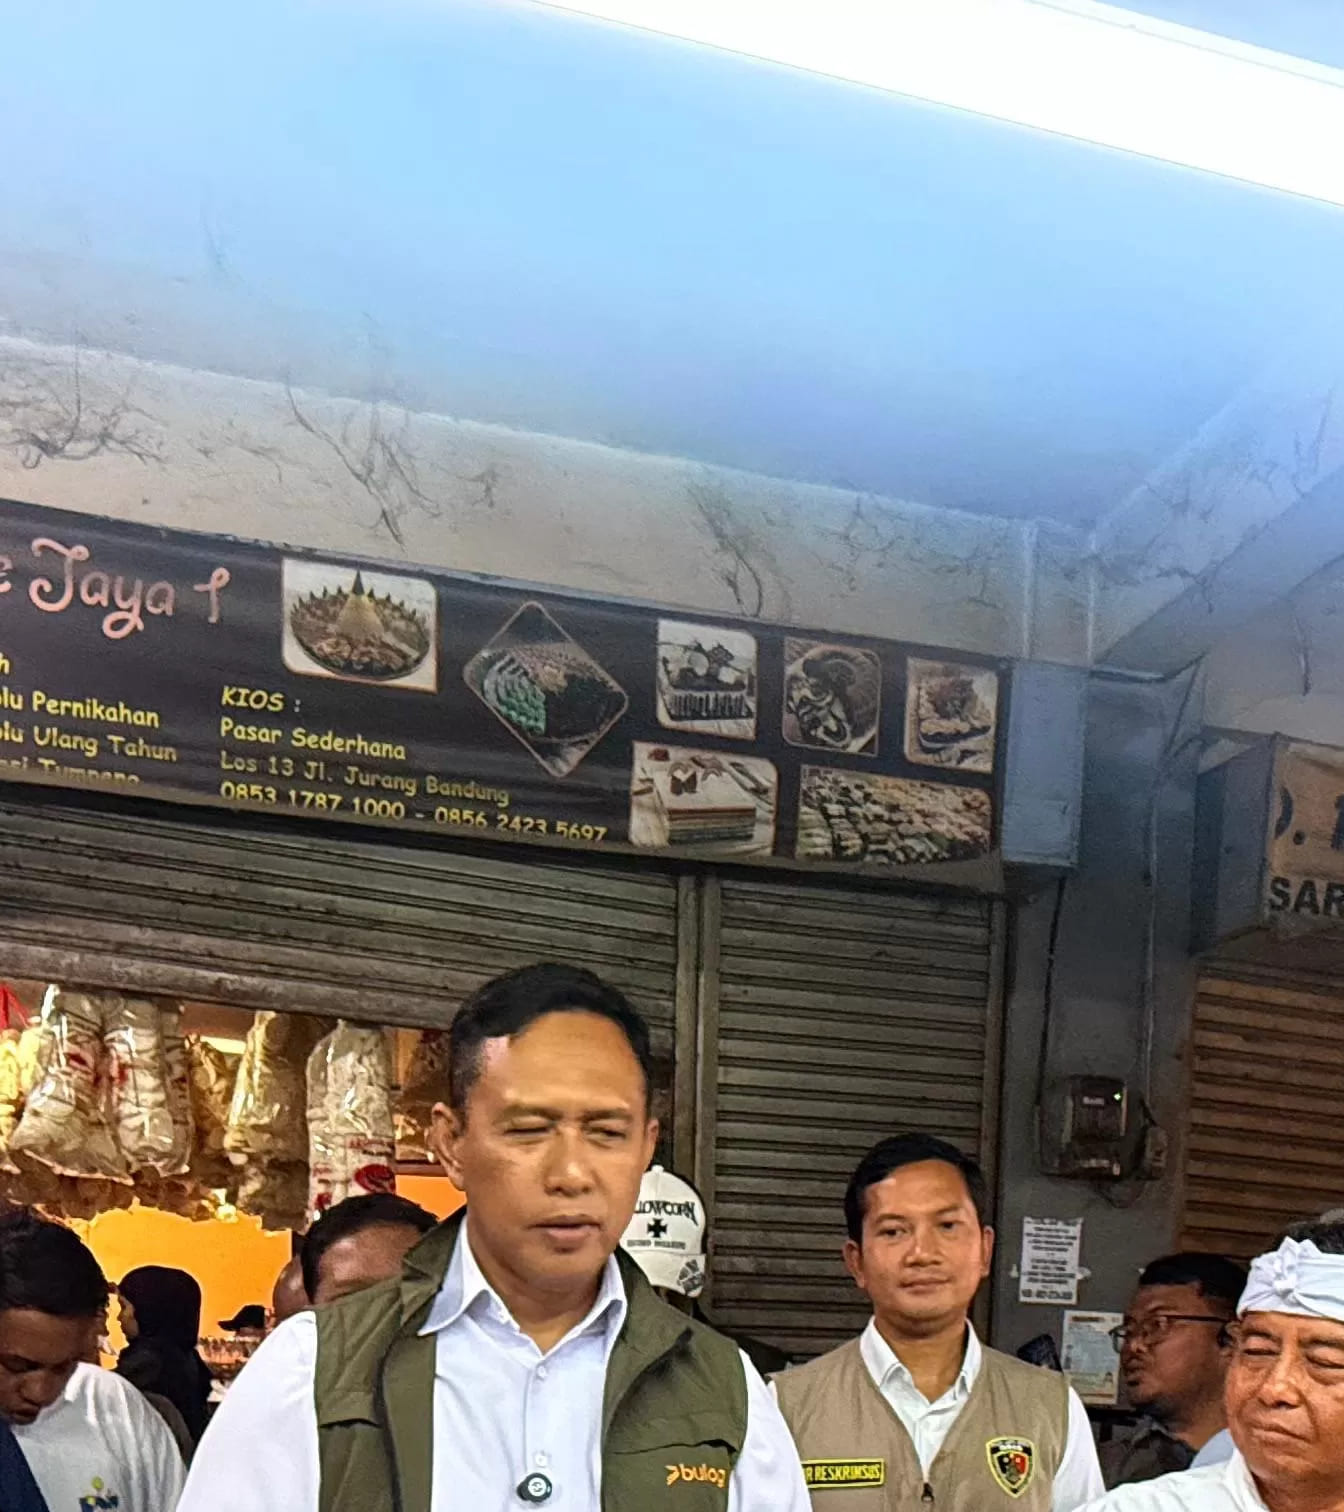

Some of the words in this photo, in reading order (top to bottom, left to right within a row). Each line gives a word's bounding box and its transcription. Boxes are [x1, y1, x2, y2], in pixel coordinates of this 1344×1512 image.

[29, 537, 175, 640] Jaya
[32, 690, 159, 728] Pernikahan
[221, 685, 285, 712] KIOS
[33, 726, 98, 758] Ulang
[108, 735, 177, 762] Tahun
[220, 716, 283, 744] Pasar
[291, 727, 406, 760] Sederhana
[220, 750, 258, 772] Los
[268, 756, 294, 776] 13
[344, 765, 417, 797] Jurang
[425, 774, 510, 808] Bandung
[220, 781, 277, 805] 0853
[288, 789, 343, 813] 1787
[353, 796, 405, 820] 1000
[434, 806, 488, 830] 0856
[496, 814, 547, 834] 2423
